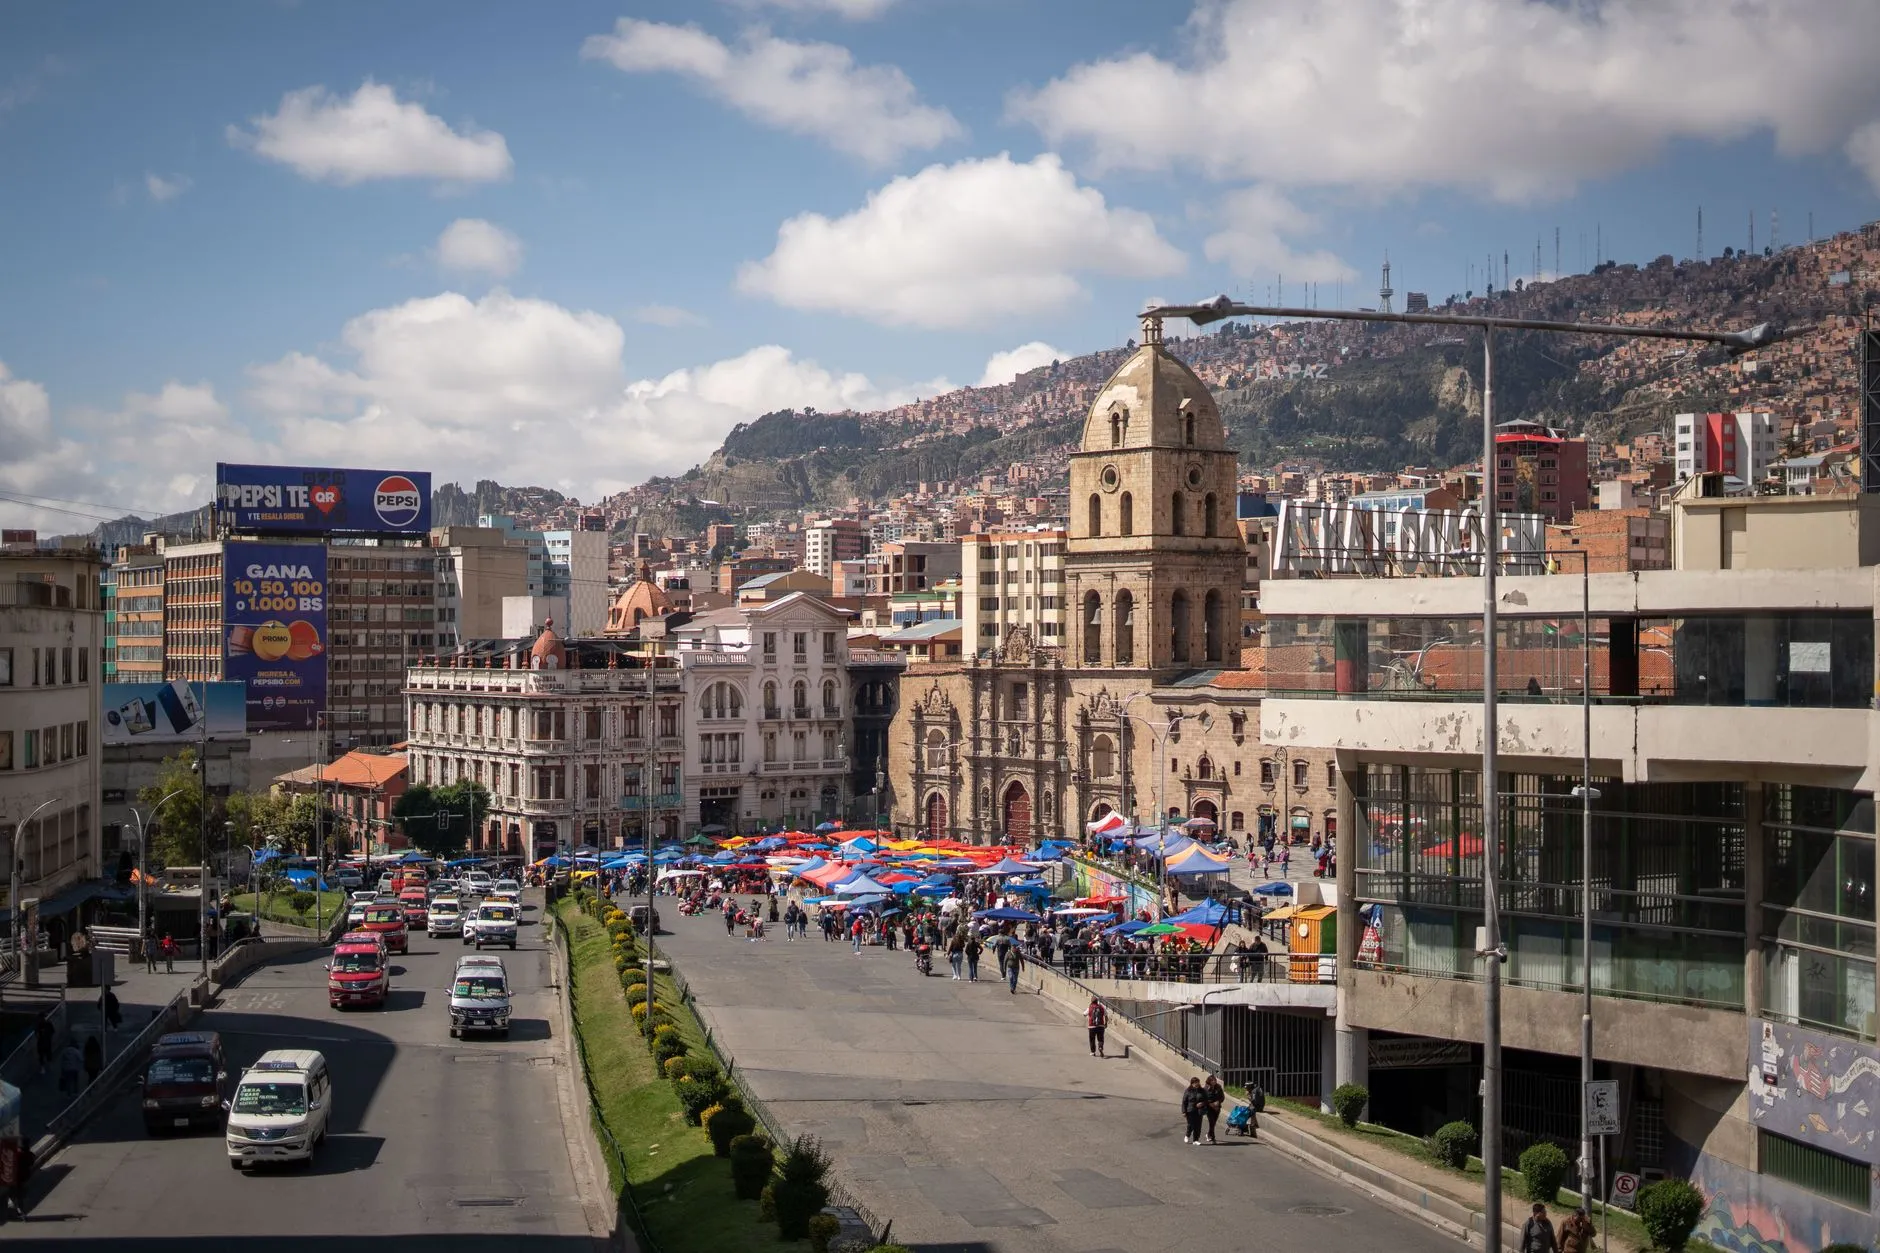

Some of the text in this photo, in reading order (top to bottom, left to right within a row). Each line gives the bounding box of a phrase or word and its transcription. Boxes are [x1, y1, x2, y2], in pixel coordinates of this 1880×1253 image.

[228, 484, 282, 508] PEPSI
[286, 485, 309, 508] TE
[314, 491, 336, 504] QR
[376, 494, 418, 507] PEPSI
[247, 512, 252, 521] Y
[253, 512, 261, 521] TE
[246, 564, 313, 579] GANA
[233, 581, 323, 597] 10, 50, 100
[248, 597, 297, 611] 1.000
[299, 597, 323, 611] BS
[262, 635, 288, 643] PROMO
[257, 671, 288, 679] INGRESA
